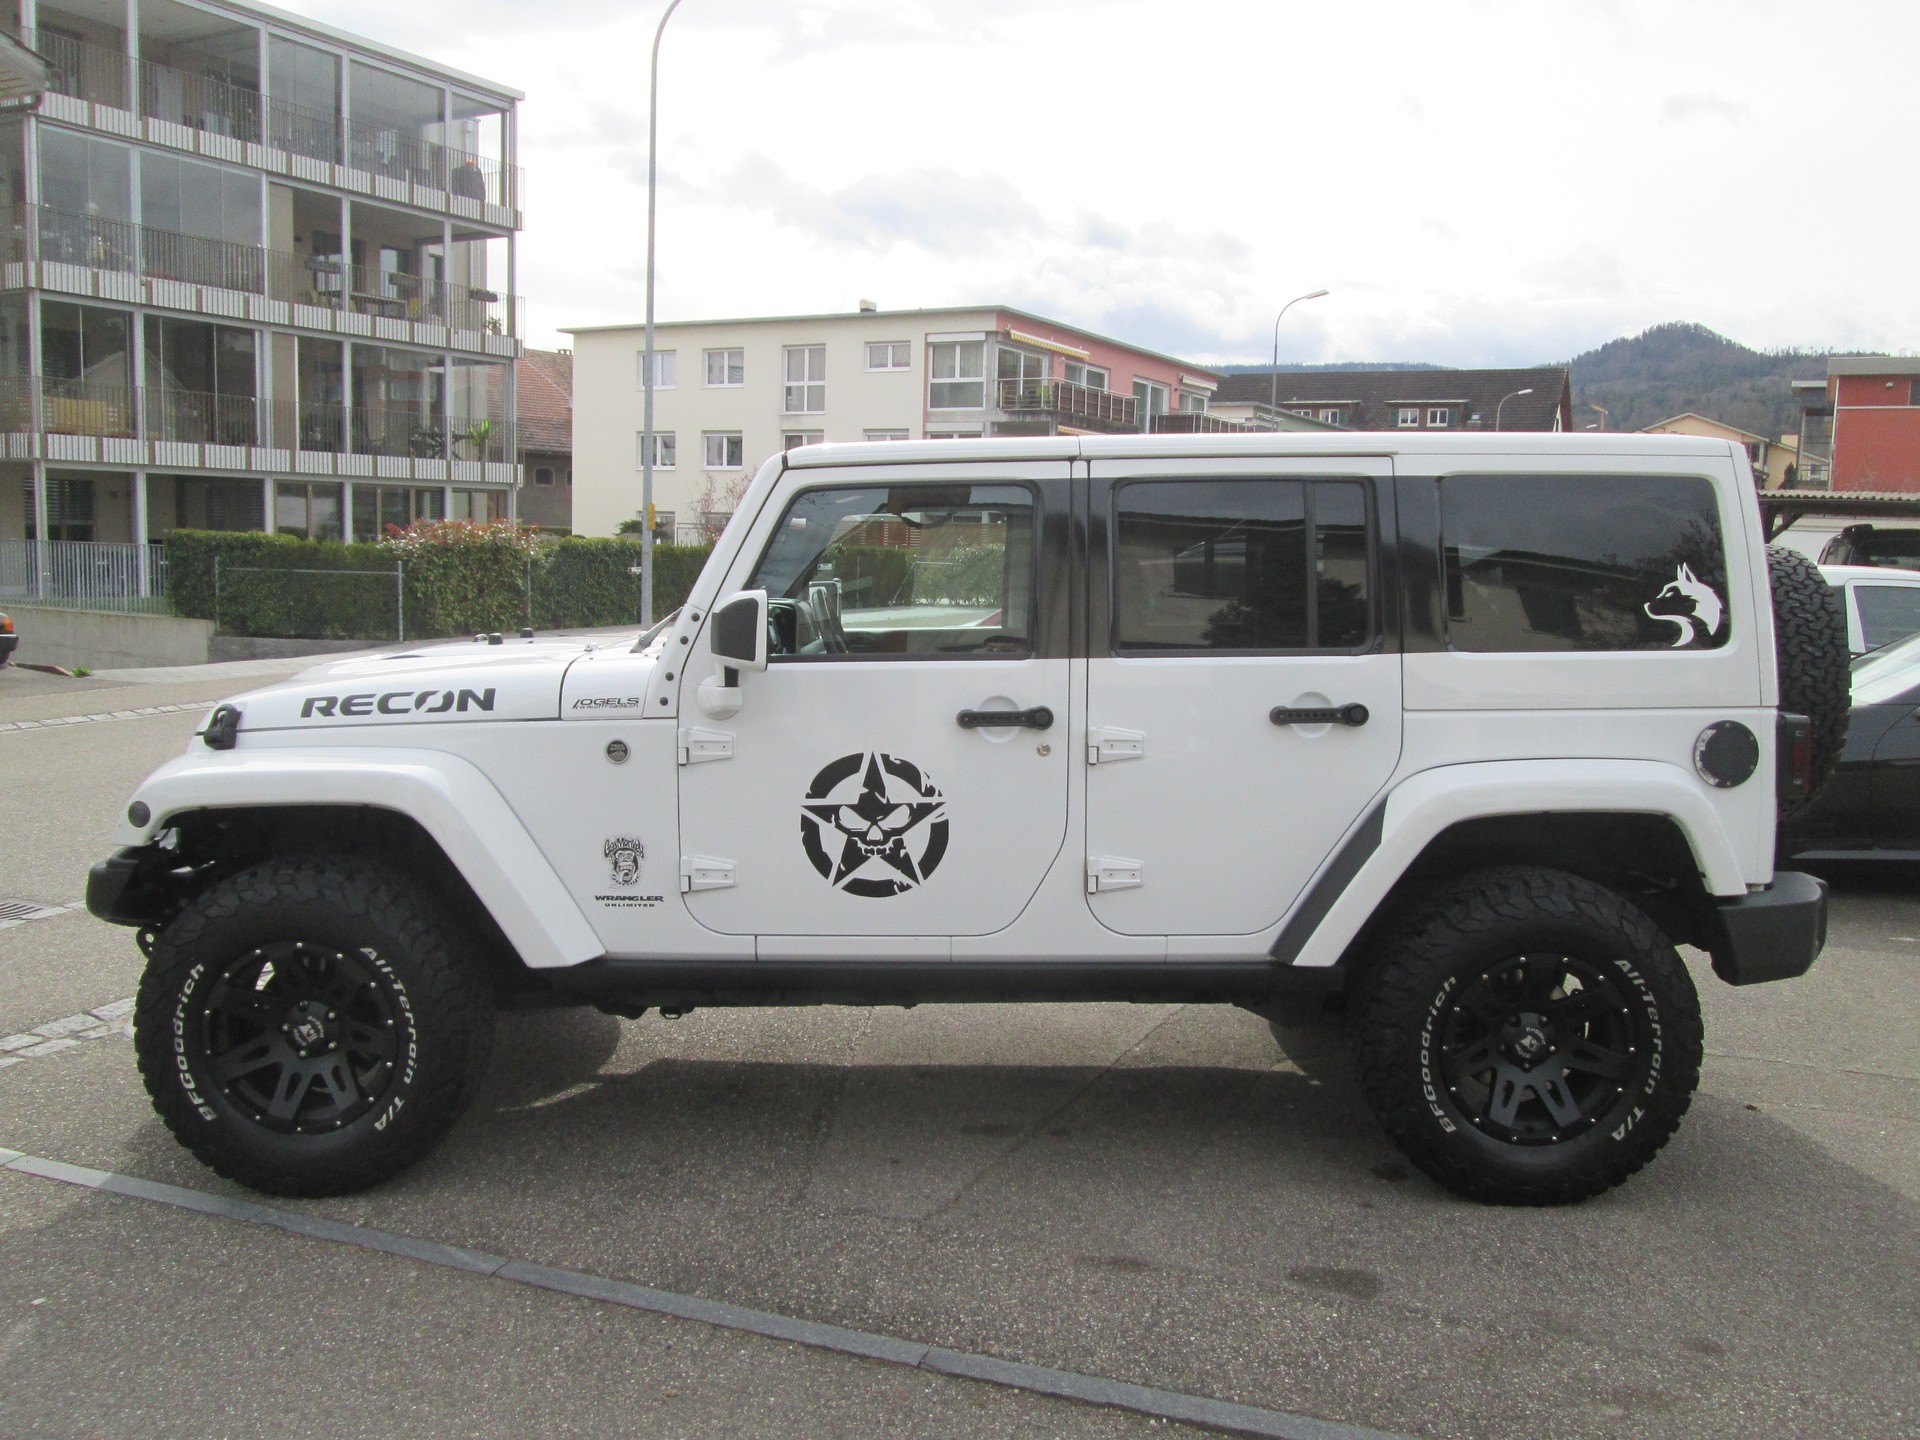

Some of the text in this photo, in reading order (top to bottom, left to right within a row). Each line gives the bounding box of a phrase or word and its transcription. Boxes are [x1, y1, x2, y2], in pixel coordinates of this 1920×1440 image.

[301, 688, 496, 718] RECON
[173, 963, 218, 1121] BFGoodrich
[359, 947, 418, 1085] All-Terrain
[1421, 976, 1456, 1133] BFGoodrich
[1613, 960, 1662, 1095] All-Terrain
